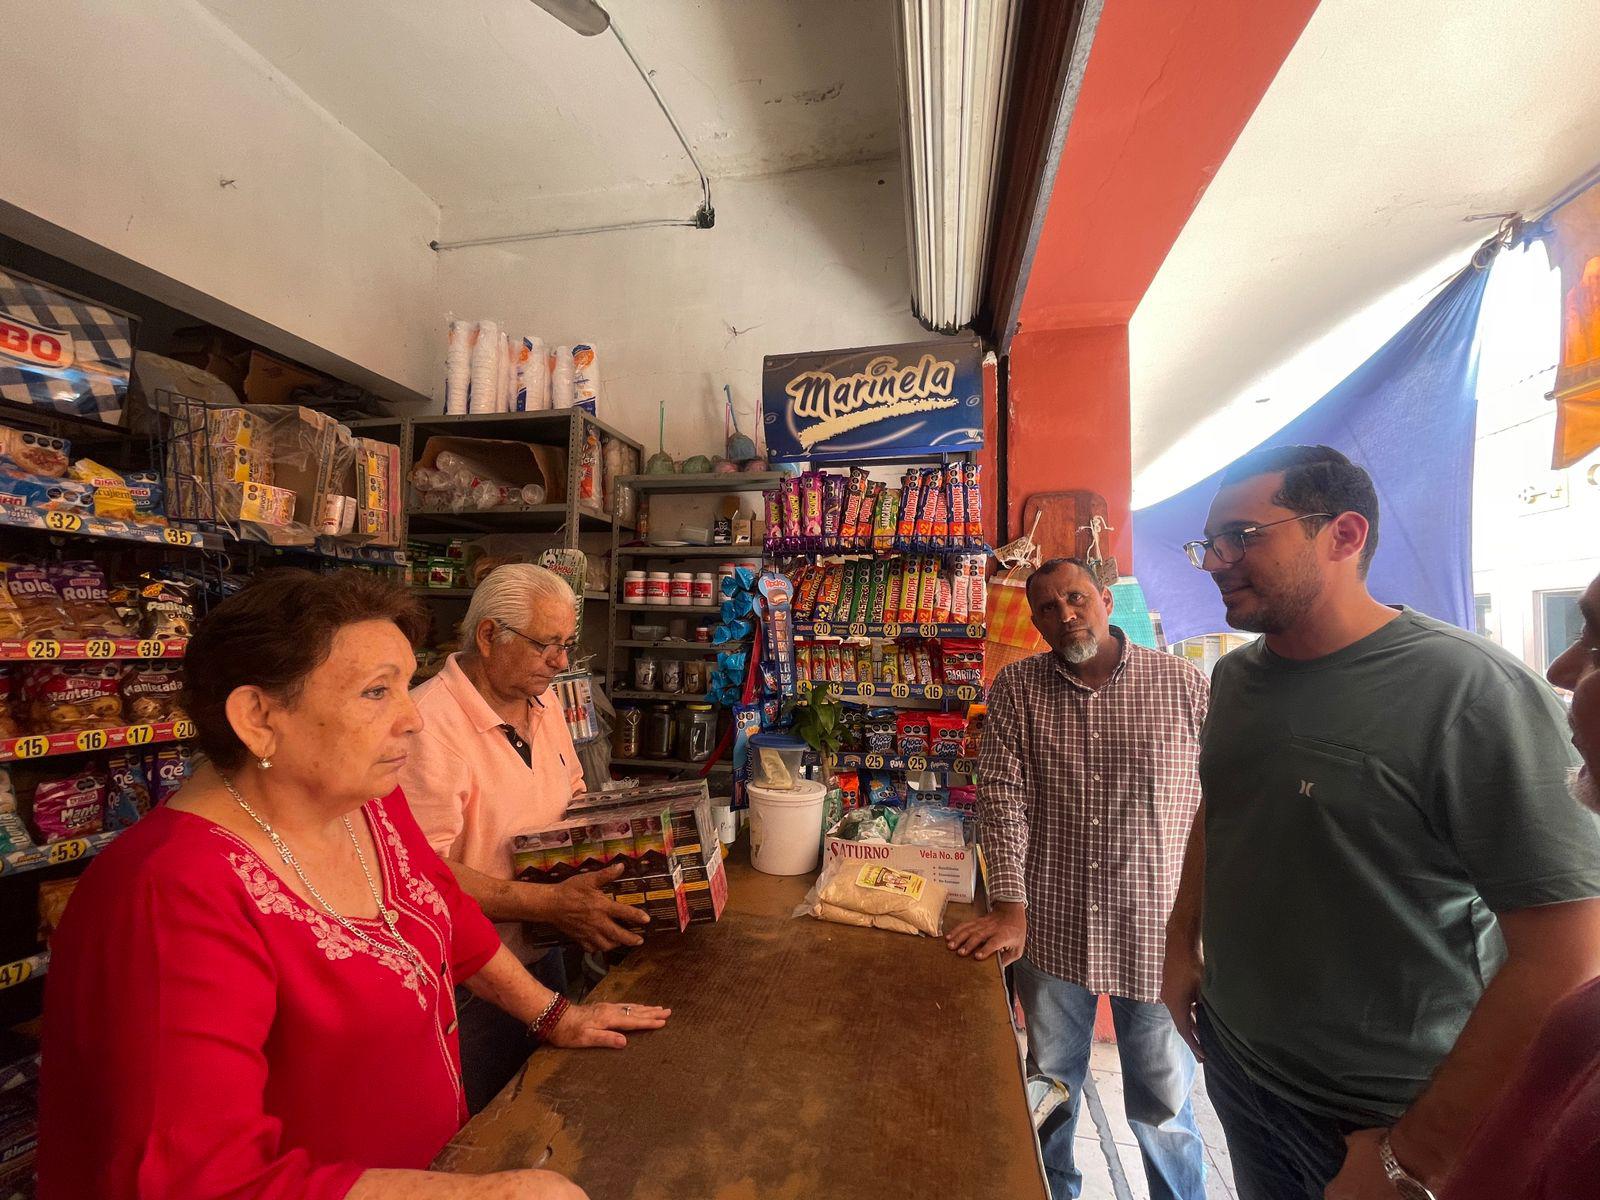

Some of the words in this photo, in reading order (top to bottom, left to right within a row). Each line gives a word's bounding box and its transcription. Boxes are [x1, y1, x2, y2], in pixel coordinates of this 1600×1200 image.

[788, 355, 954, 419] Marinela
[160, 761, 185, 780] Qé
[830, 841, 890, 860] SATURNO
[920, 850, 937, 859] Vela
[939, 851, 953, 860] No.
[954, 851, 965, 861] 80
